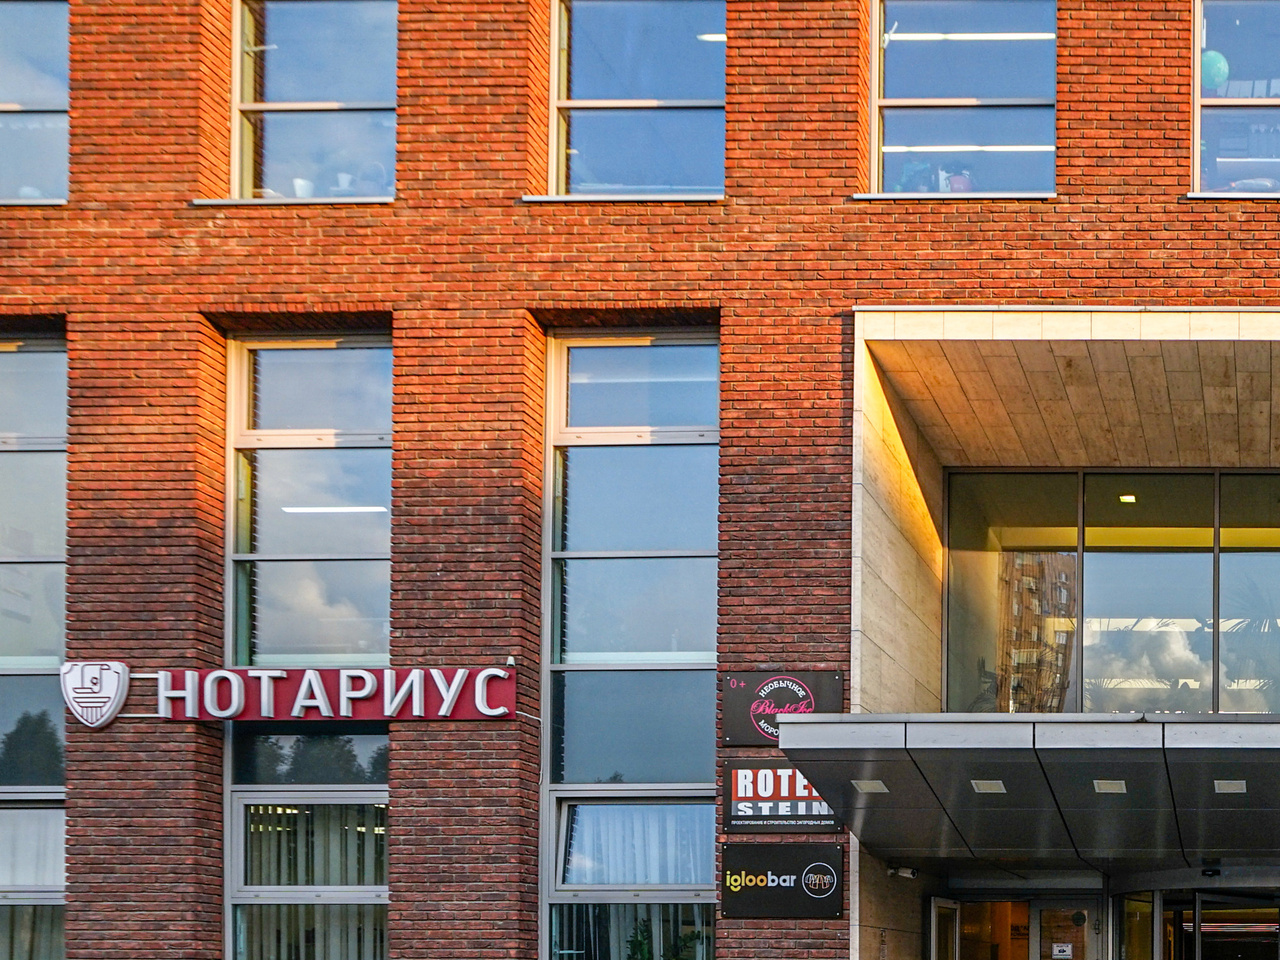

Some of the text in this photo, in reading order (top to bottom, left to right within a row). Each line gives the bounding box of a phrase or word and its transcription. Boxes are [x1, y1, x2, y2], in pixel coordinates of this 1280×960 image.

[158, 667, 510, 719] НОТАРИУС
[758, 680, 806, 698] НЕОБЫЧНОЕ
[737, 768, 820, 798] ROTE
[737, 801, 829, 815] STEIN
[726, 870, 797, 892] igloobar
